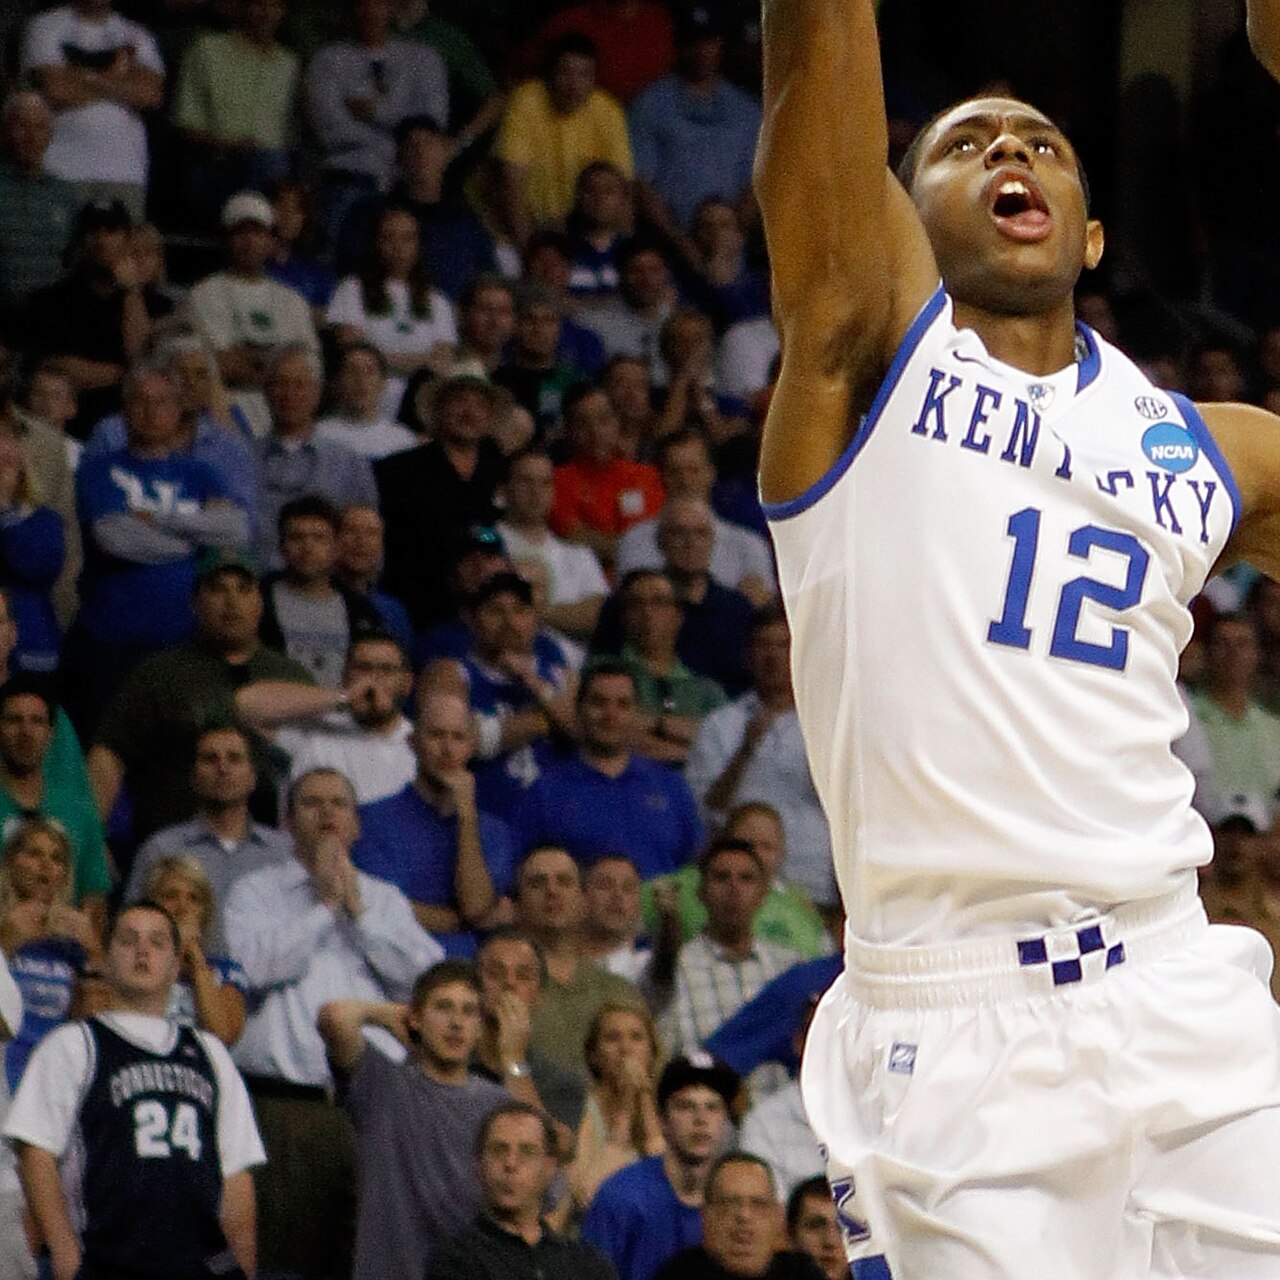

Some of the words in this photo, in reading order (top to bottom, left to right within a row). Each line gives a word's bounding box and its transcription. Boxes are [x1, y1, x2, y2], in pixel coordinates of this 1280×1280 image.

[911, 368, 1217, 545] KENKY
[1150, 443, 1194, 460] NCAA
[986, 506, 1150, 672] 12
[134, 1100, 201, 1161] 24
